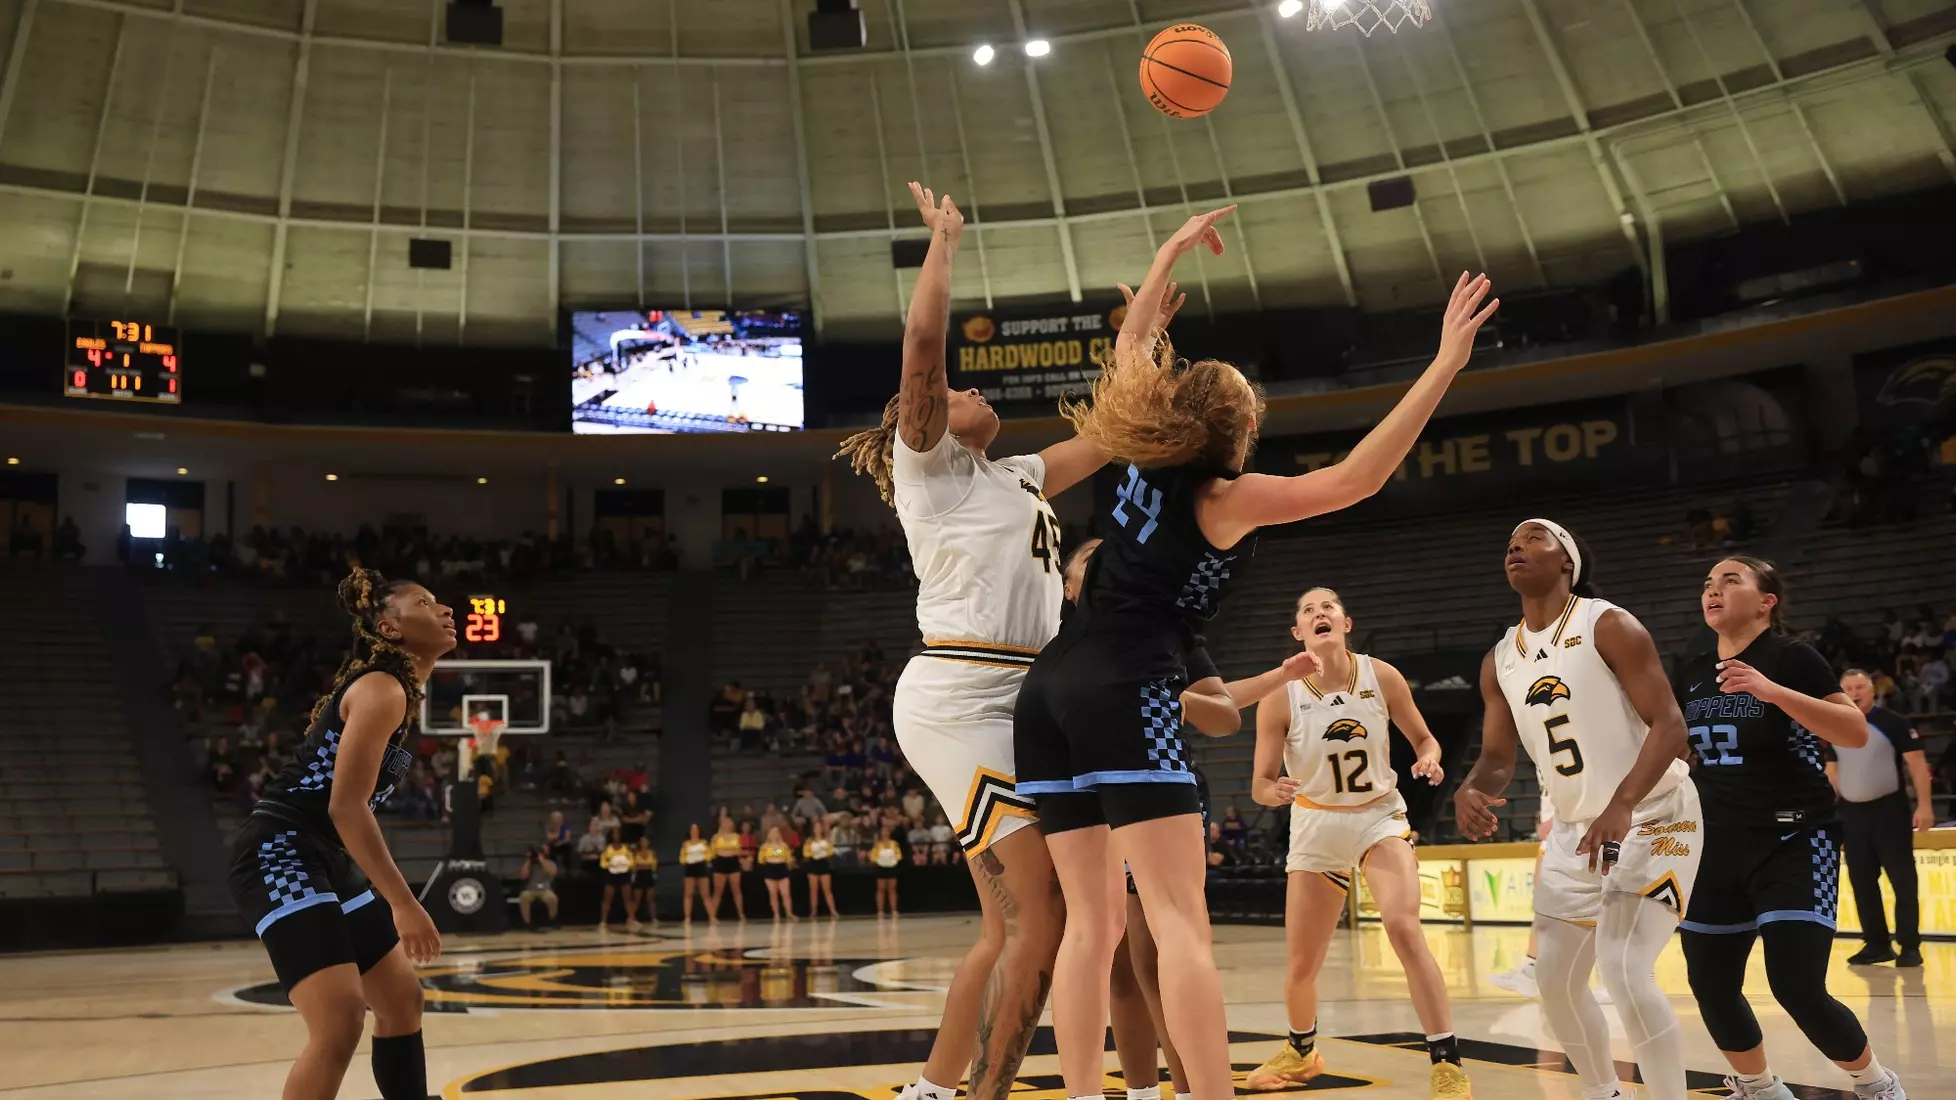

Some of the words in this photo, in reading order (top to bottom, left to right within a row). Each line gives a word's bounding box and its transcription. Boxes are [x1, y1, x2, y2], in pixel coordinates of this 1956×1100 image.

[111, 320, 152, 342] 7:31
[1001, 317, 1068, 336] SUPPORT
[1071, 314, 1102, 330] THE
[87, 348, 102, 368] 4
[123, 353, 130, 368] 1
[162, 355, 177, 373] 4
[959, 340, 1082, 372] HARDWOOD
[74, 369, 86, 388] 0
[169, 378, 176, 393] 1
[1506, 420, 1617, 466] TOP
[1112, 462, 1163, 545] 24
[470, 598, 505, 615] 7:31
[465, 613, 500, 641] 23
[1564, 635, 1582, 649] SBC
[1360, 690, 1375, 699] SBC
[1543, 713, 1584, 777] 5
[1688, 724, 1744, 767] 22
[1327, 749, 1373, 794] 12
[1651, 836, 1690, 857] Miss
